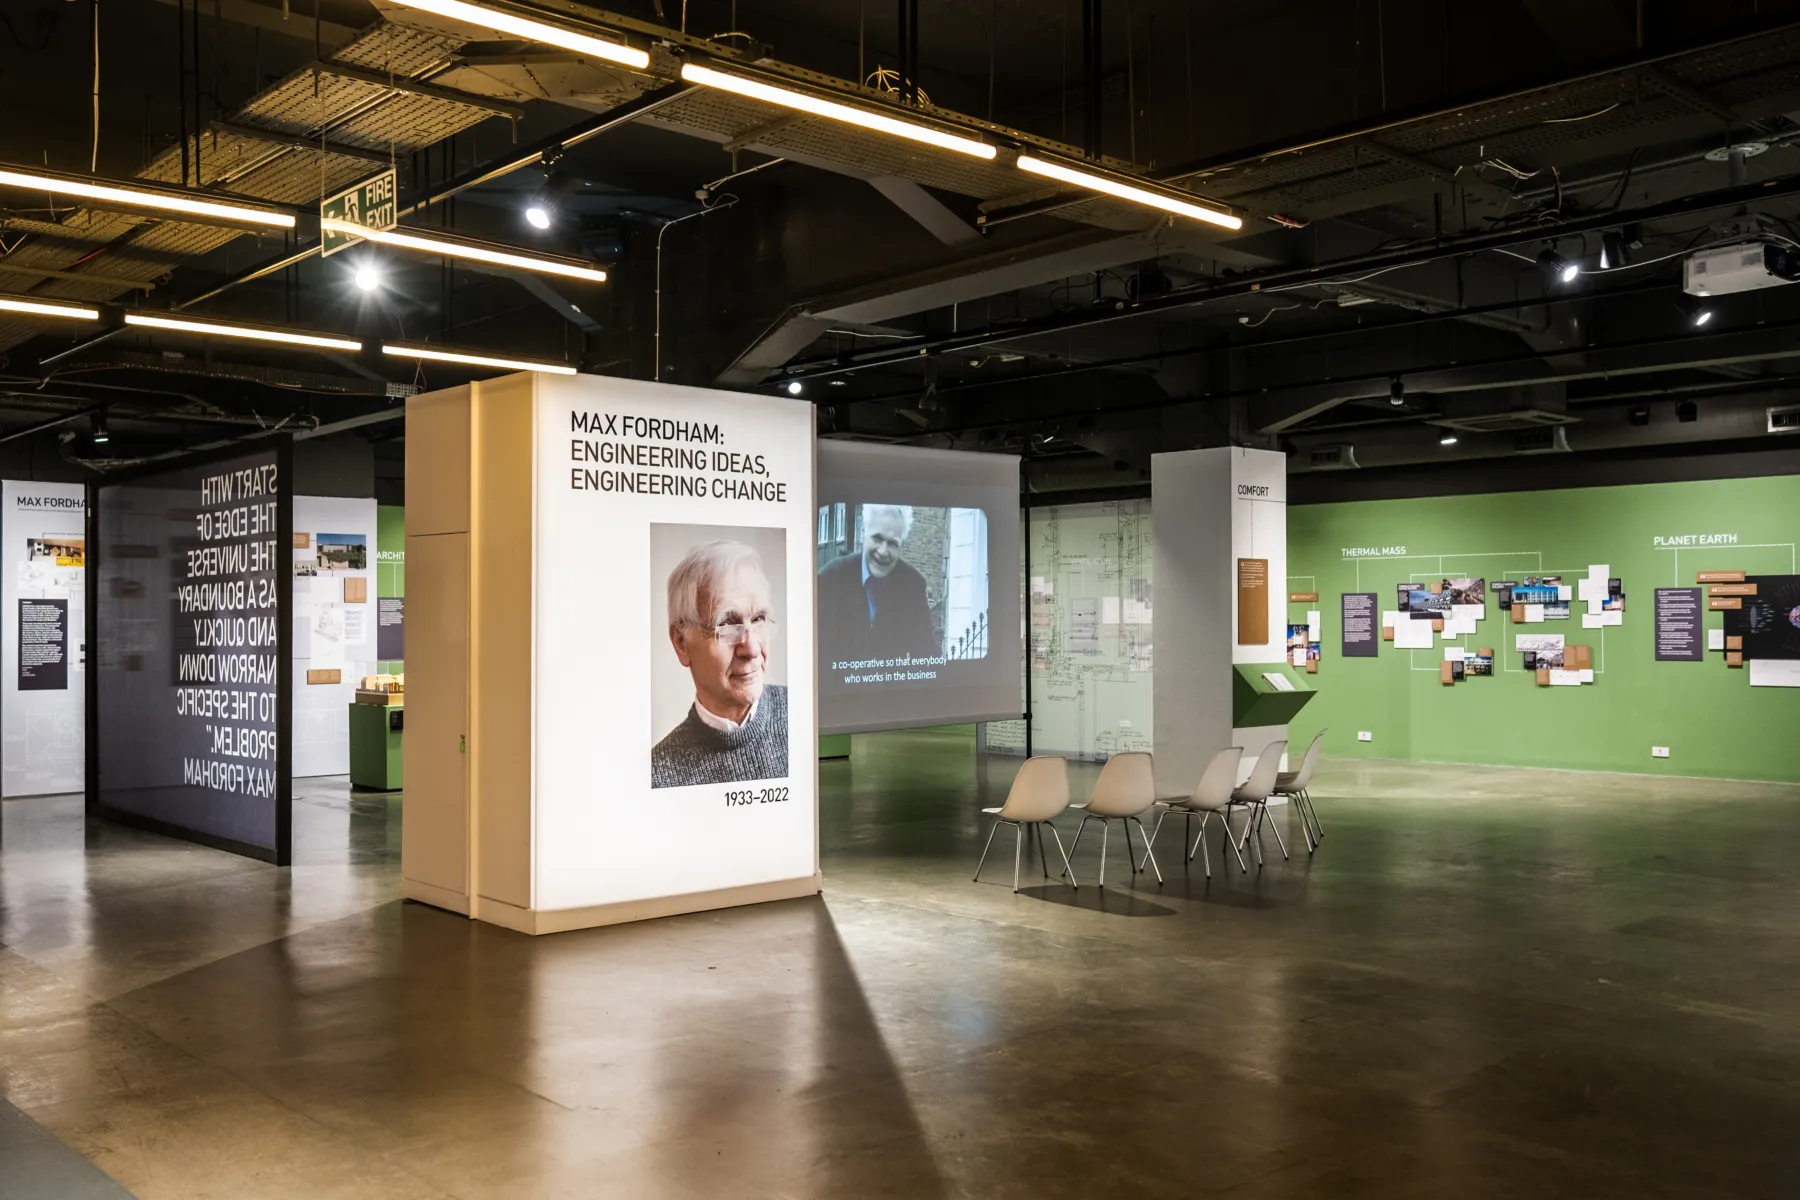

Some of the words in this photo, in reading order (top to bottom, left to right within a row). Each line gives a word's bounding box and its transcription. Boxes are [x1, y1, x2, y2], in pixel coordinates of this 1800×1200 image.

[366, 175, 392, 207] FIRE
[366, 202, 393, 230] EXIT
[571, 410, 617, 436] MAX
[622, 415, 725, 445] FORDHAM:
[571, 439, 707, 470] ENGINEERING
[712, 451, 770, 479] IDEAS,
[571, 468, 707, 498] ENGINEERING
[711, 478, 787, 503] CHANGE
[1238, 484, 1269, 497] COMFORT
[17, 496, 41, 507] MAX
[1653, 535, 1697, 546] PLANET
[1699, 533, 1738, 545] EARTH
[1341, 547, 1381, 557] THERMAL
[1382, 545, 1407, 556] MASS
[832, 661, 837, 670] a
[838, 658, 884, 670] co-operative
[886, 659, 894, 667] so
[895, 656, 910, 667] that
[911, 655, 948, 666] everybody
[844, 673, 861, 684] who
[862, 672, 884, 683] works
[885, 671, 892, 682] in
[893, 671, 906, 681] the
[907, 670, 937, 680] business
